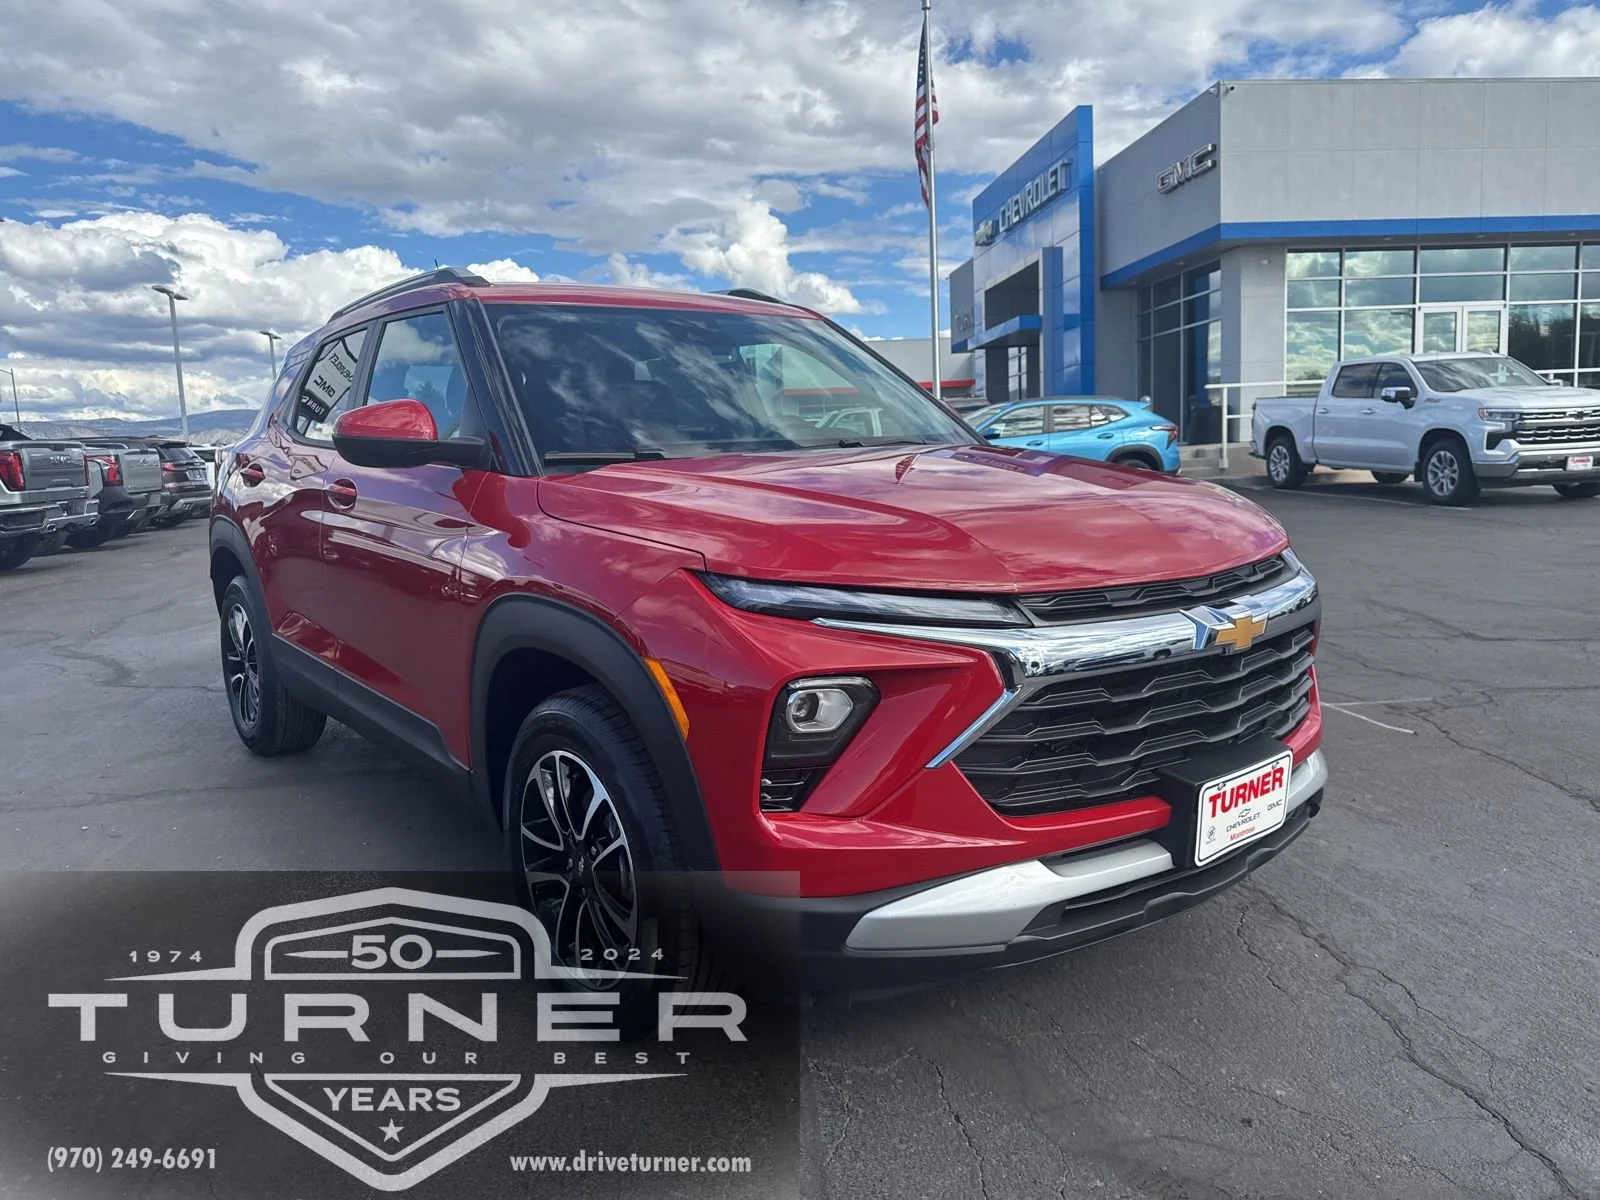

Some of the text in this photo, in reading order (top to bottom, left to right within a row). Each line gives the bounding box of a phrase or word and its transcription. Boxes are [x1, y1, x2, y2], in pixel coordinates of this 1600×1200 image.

[1156, 143, 1217, 194] GMC
[999, 160, 1072, 232] CHEVROLET
[1209, 767, 1284, 818] TURNER
[1226, 812, 1261, 832] CHEVROLET
